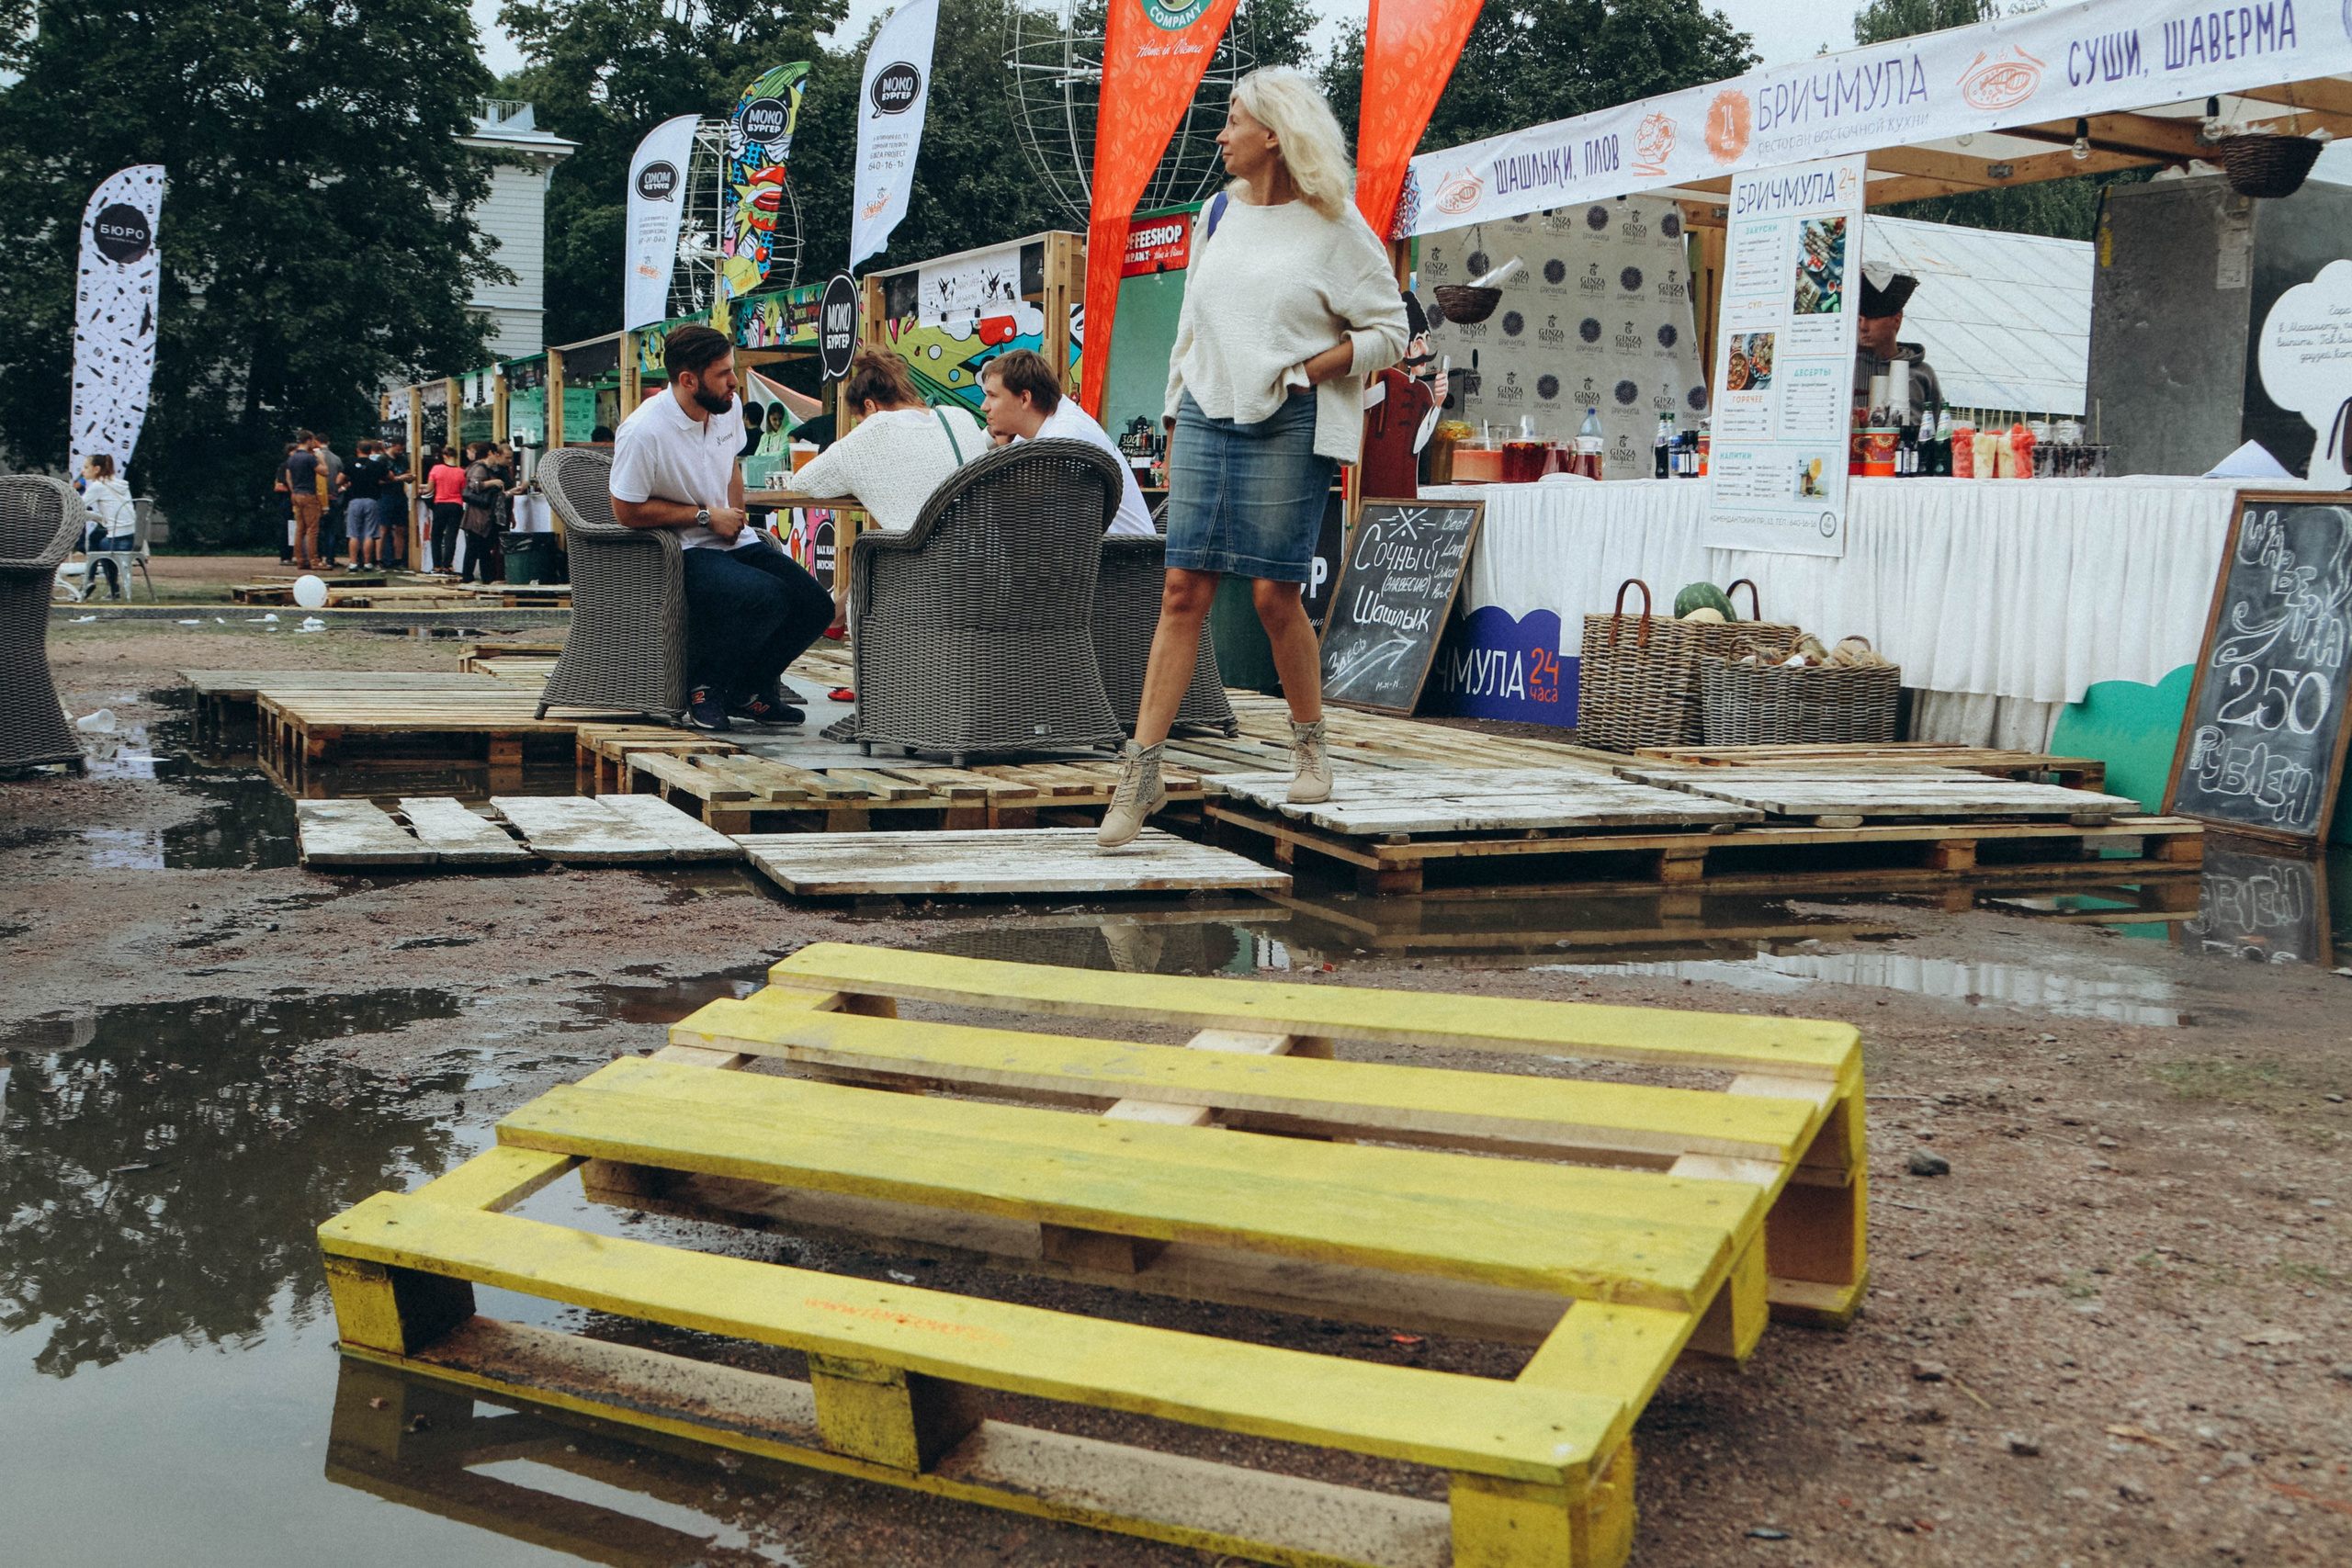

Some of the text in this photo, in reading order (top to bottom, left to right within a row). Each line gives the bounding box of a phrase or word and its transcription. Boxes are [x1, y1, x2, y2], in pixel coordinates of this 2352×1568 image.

[1149, 2, 1202, 28] COMPANY
[1136, 39, 1161, 58] Home
[1162, 43, 1171, 55] in
[2069, 0, 2297, 87] СУШИ, ШАВЕРМА
[882, 76, 914, 93] МОКО
[1758, 53, 1928, 132] БРИЧМУЛА
[881, 91, 912, 102] БУРГЕР
[748, 108, 784, 126] МОКО
[1721, 104, 1735, 140] 24
[747, 123, 782, 134] БУРГЕР
[1758, 112, 1929, 159] ресторан восточной кухни
[1493, 133, 1621, 196] ШАШЛЫКИ, ПЛОВ
[1838, 166, 1856, 190] 24
[1736, 170, 1837, 215] БРИЧМУЛА
[1553, 216, 1571, 224] INZA
[1623, 223, 1647, 233] GINZA
[100, 223, 145, 240] БЮРО
[1125, 224, 1182, 251] FFEESHOP
[1515, 270, 1530, 279] NZA
[1580, 276, 1606, 288] GINZA
[1658, 282, 1685, 293] GINZA
[1747, 300, 1762, 310] СУП
[827, 302, 852, 333] МОКО
[827, 333, 851, 350] БУРГЕР
[1538, 328, 1565, 339] GINZA
[1615, 334, 1643, 344] GINZA
[1793, 367, 1831, 378] ДЕСЕРТЫ
[1498, 386, 1523, 395] GINZA
[1498, 392, 1523, 402] PROJECT
[1574, 390, 1600, 400] GINZA
[1732, 395, 1763, 403] ГОРЯЧЕЕ
[1610, 449, 1636, 458] GINZA
[1610, 456, 1636, 465] PROJECT
[1442, 509, 1474, 531] Beef
[1354, 523, 1442, 571] Сочный
[1352, 584, 1433, 634] Шашлык
[1435, 647, 1560, 701] ЧМУЛА 24
[1530, 685, 1559, 704] часа
[2216, 663, 2332, 735] 250
